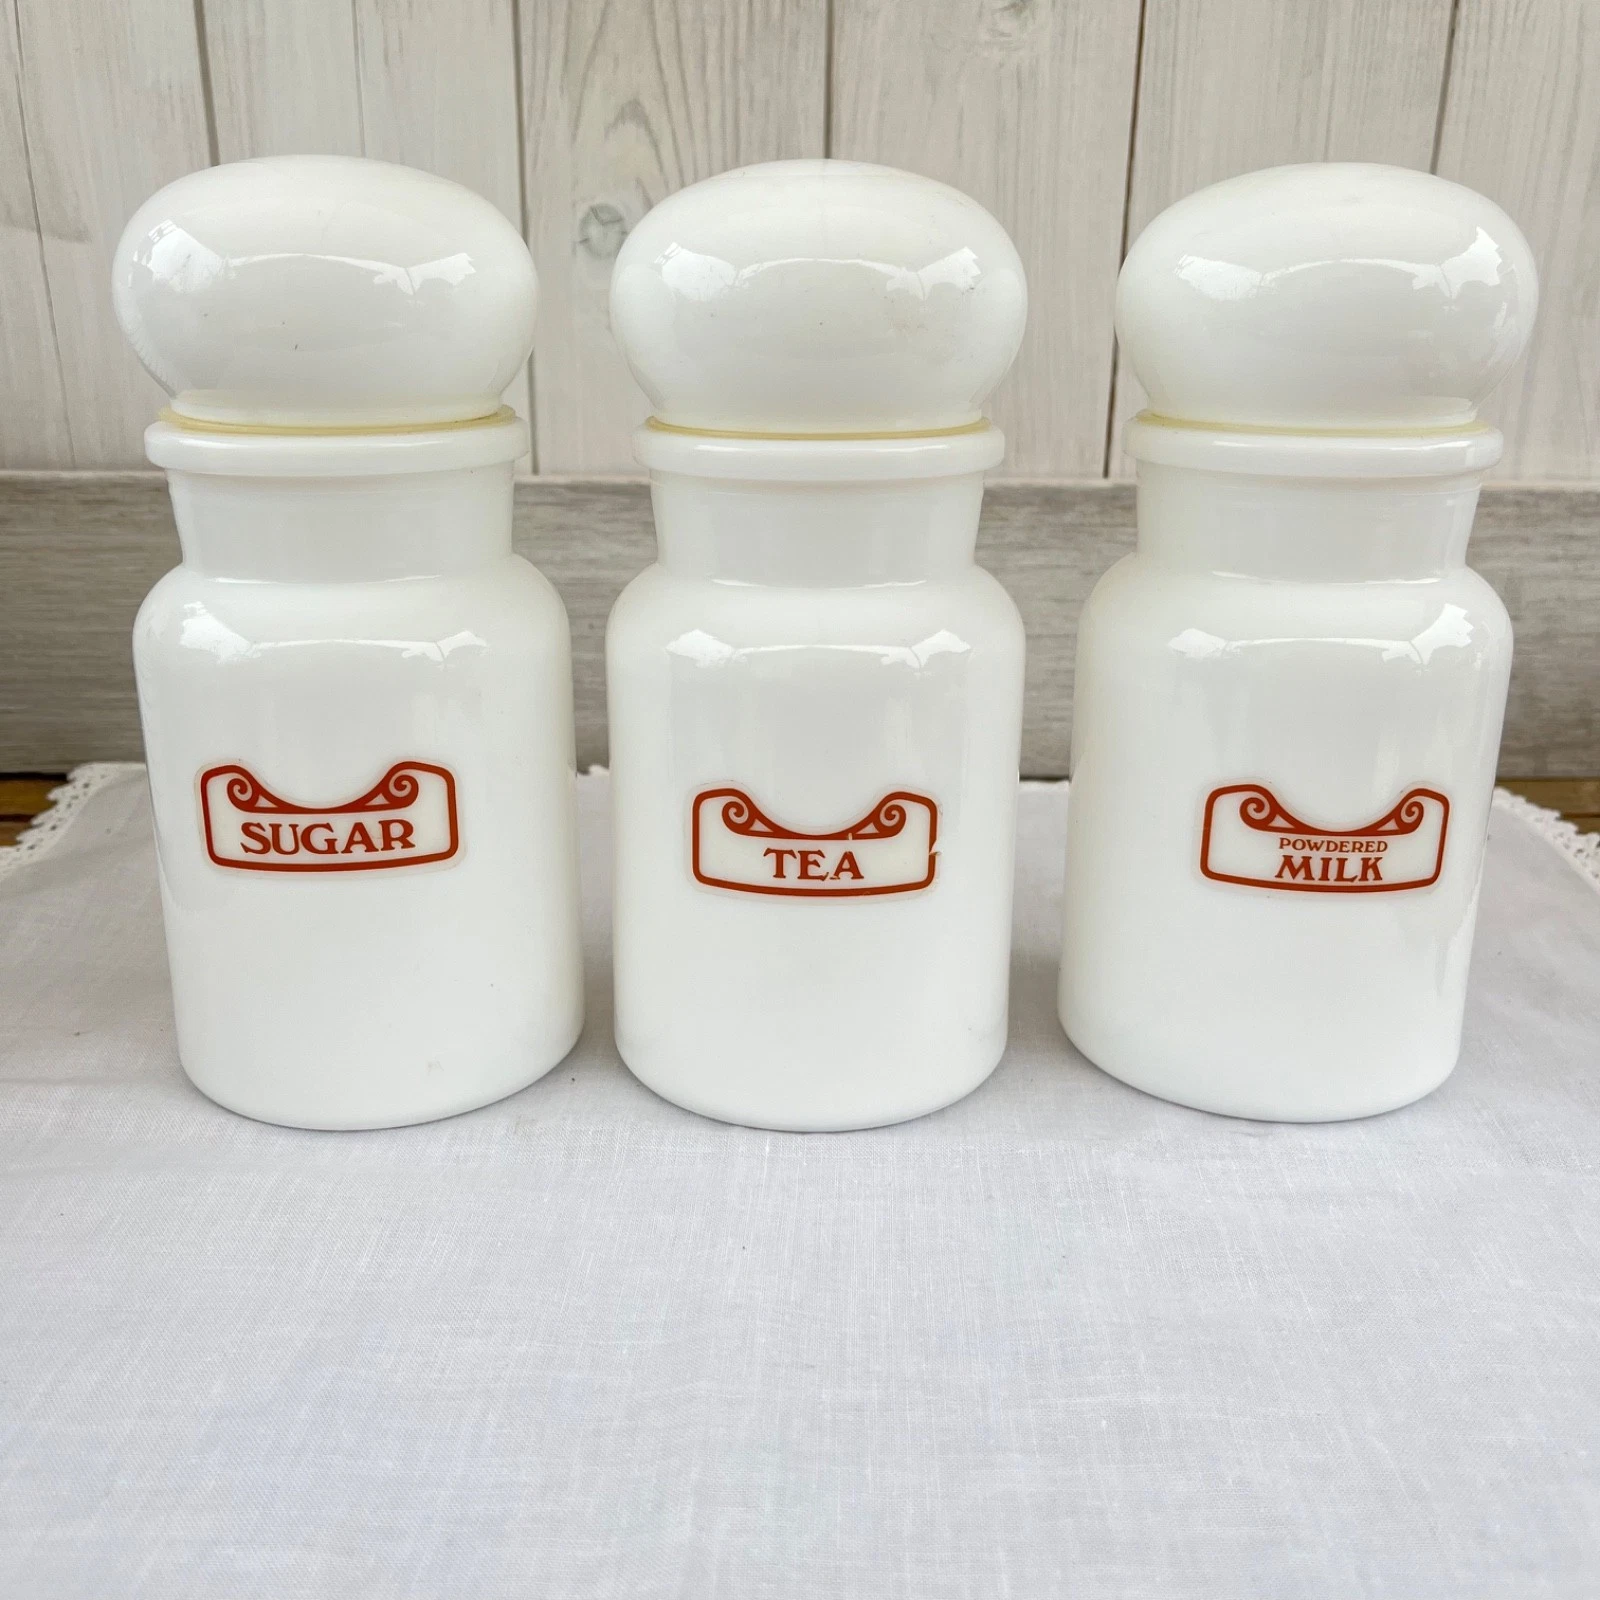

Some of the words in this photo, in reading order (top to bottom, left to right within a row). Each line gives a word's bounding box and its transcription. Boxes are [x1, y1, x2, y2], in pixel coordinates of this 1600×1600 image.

[240, 818, 416, 856] SUGAR
[1278, 837, 1388, 853] POWDERED
[763, 847, 864, 882] TEA
[1274, 855, 1384, 883] MILK
